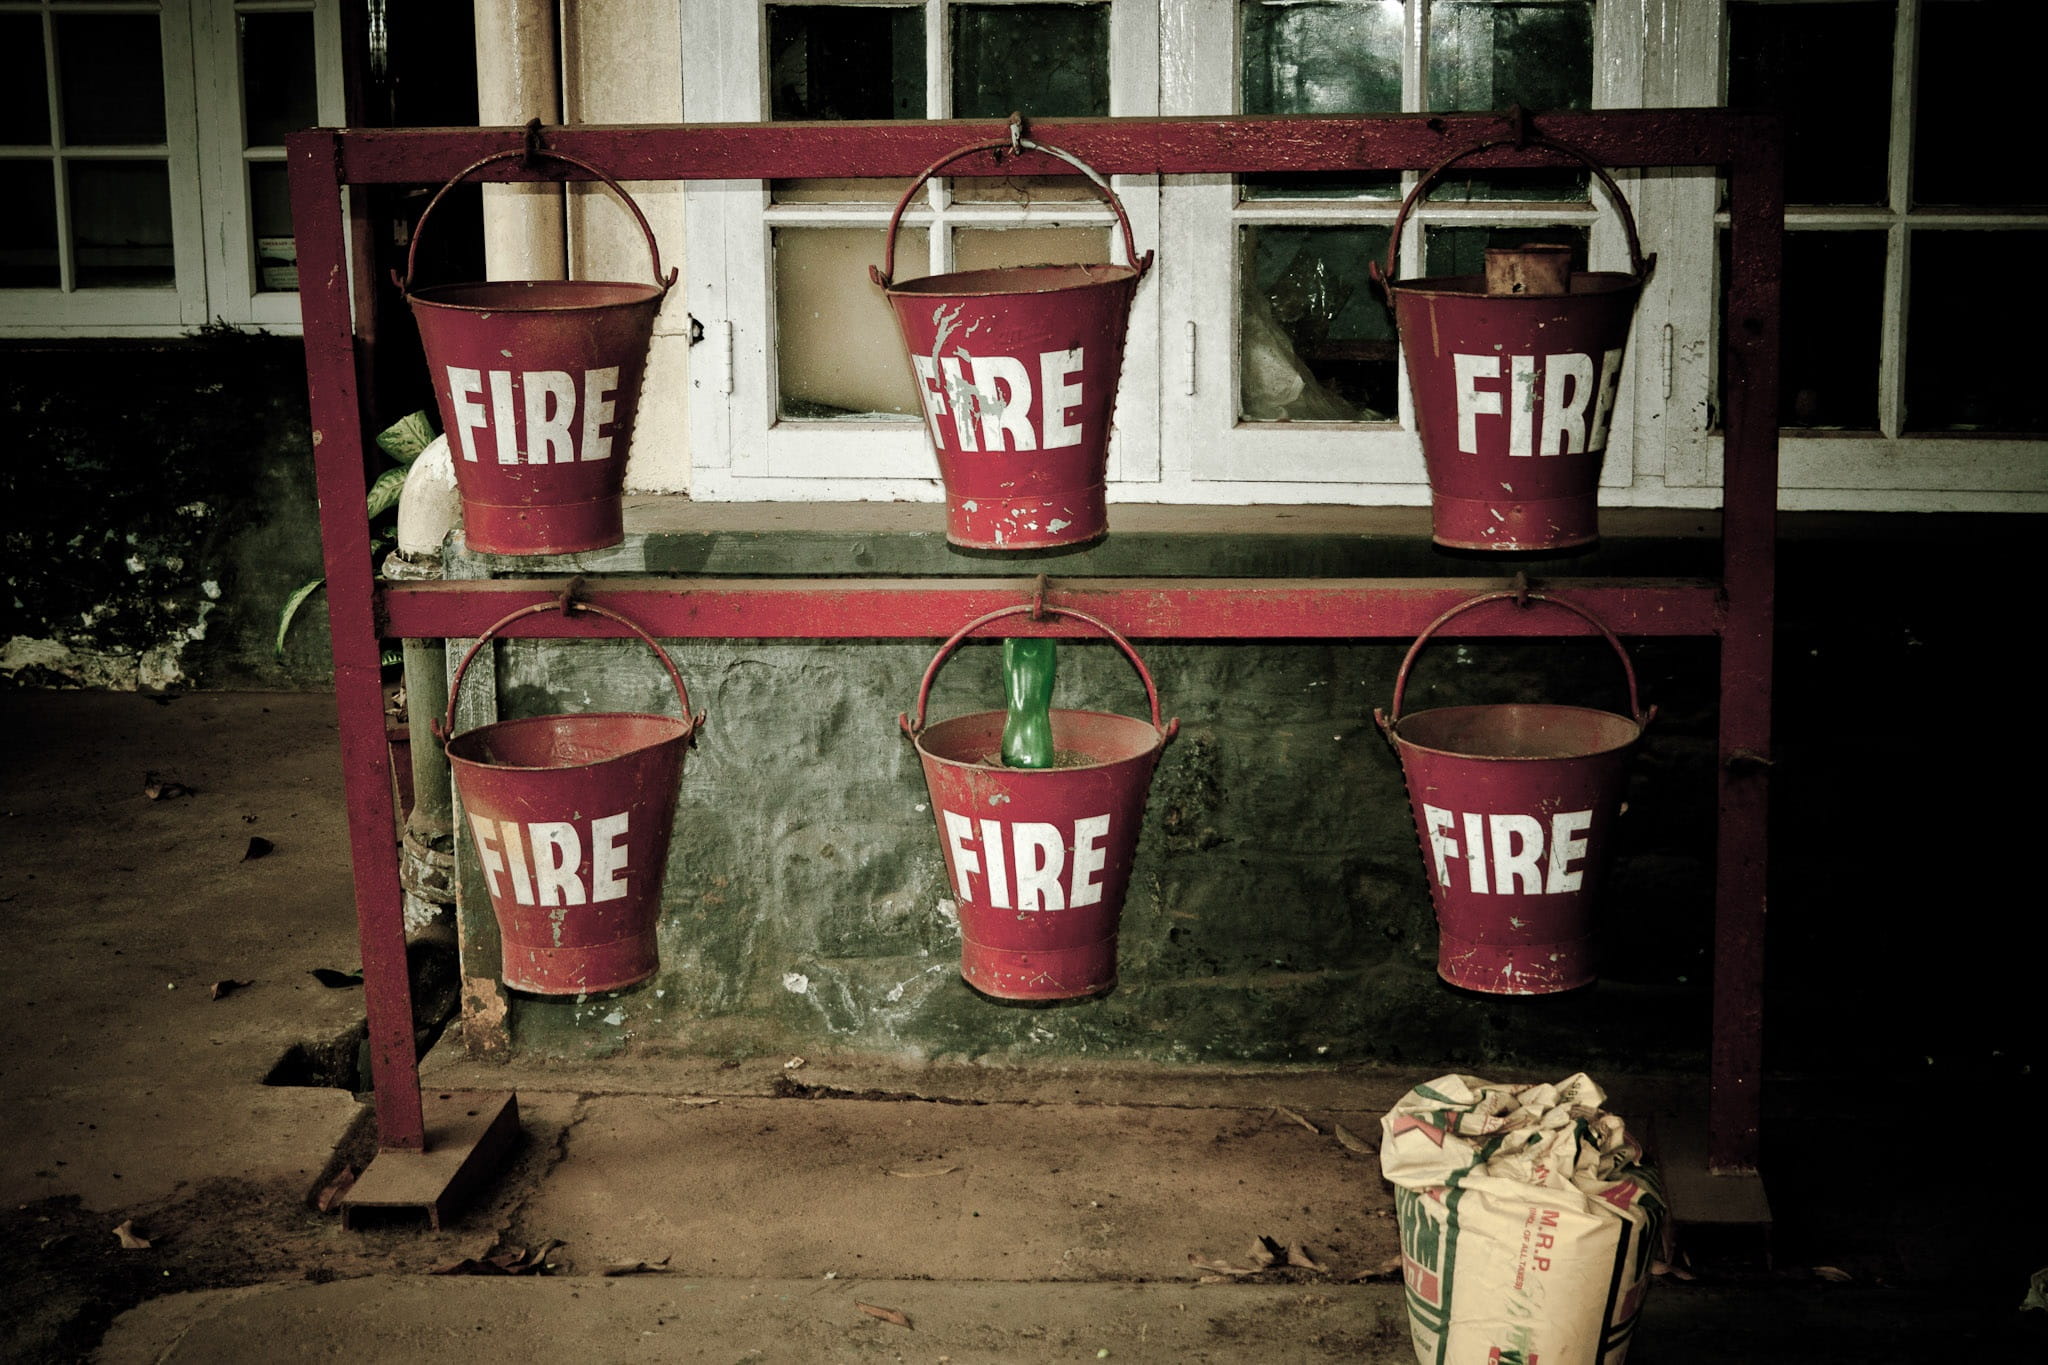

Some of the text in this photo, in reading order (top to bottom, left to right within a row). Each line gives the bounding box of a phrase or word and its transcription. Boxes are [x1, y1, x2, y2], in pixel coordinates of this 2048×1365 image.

[446, 365, 620, 465] FIRE
[911, 347, 1084, 452] FIRE
[469, 811, 629, 907] FIRE
[943, 809, 1111, 911] FIRE
[1423, 803, 1593, 895] FIRE
[1532, 1209, 1560, 1272] M.R.P.
